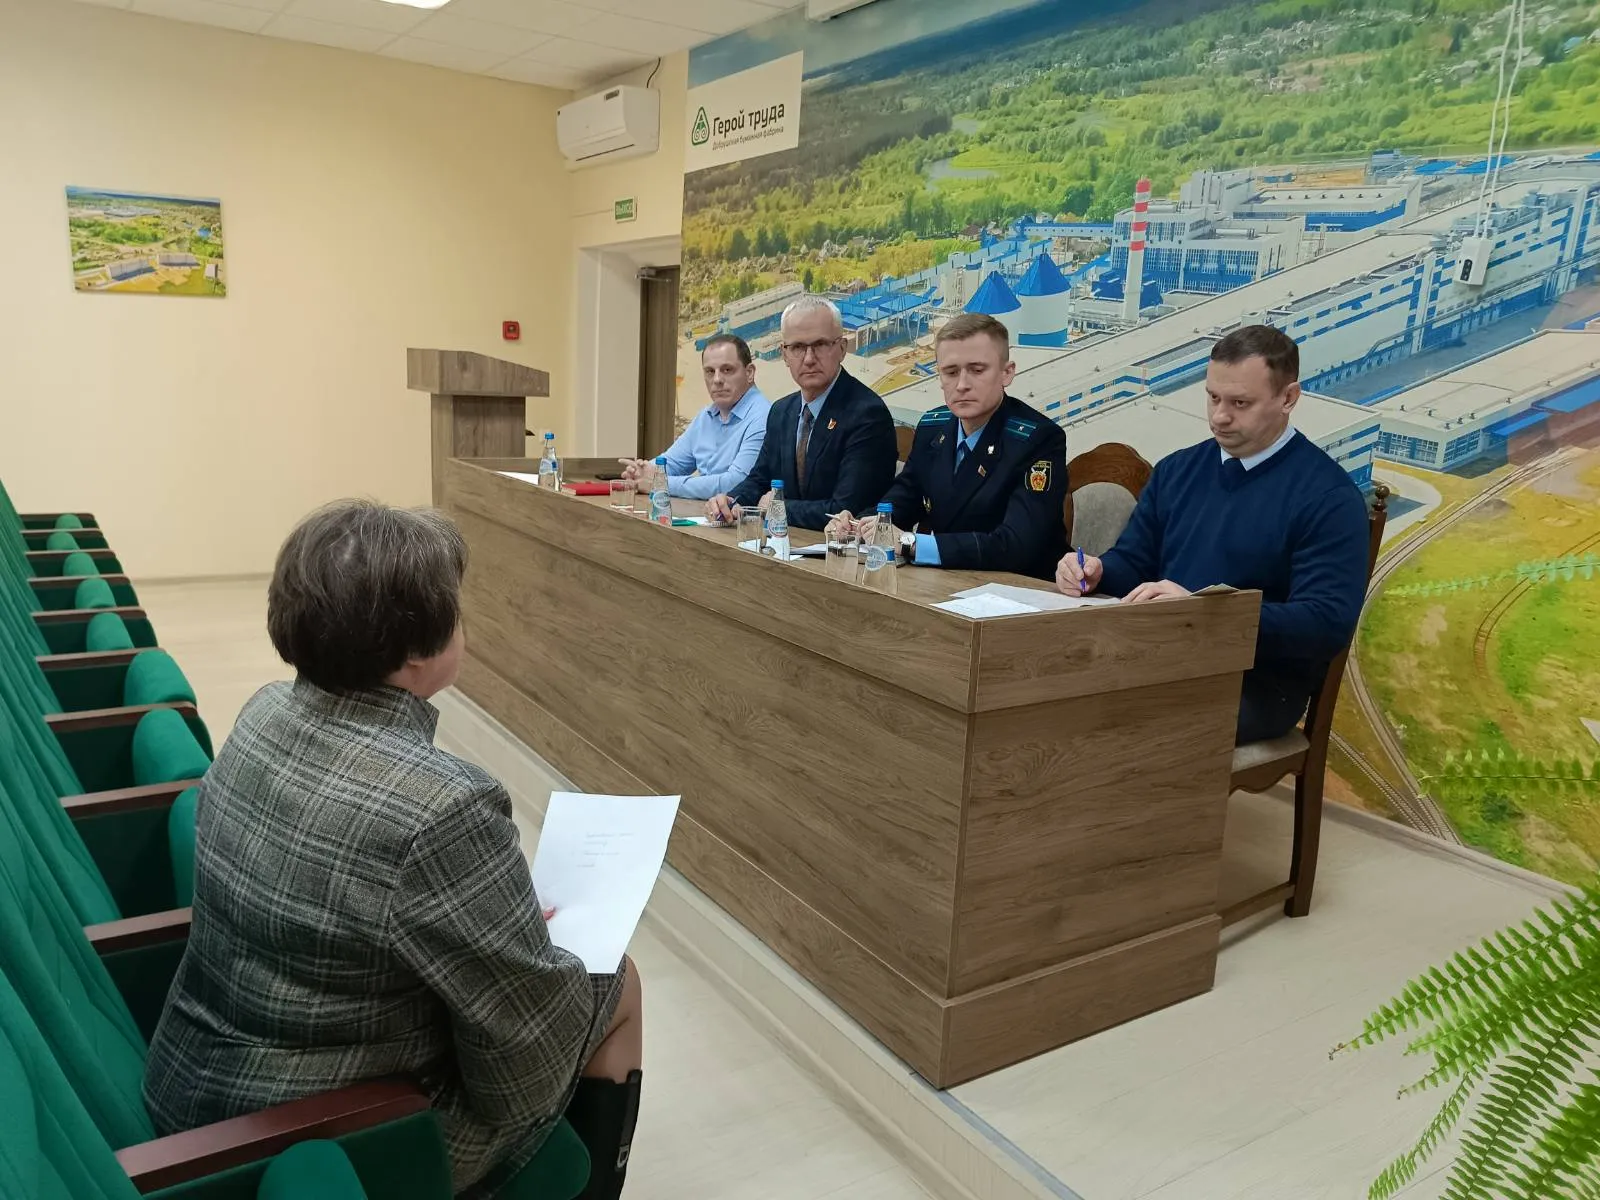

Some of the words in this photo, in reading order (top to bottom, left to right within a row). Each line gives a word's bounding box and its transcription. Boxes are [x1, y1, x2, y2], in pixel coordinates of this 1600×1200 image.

[713, 109, 745, 139] Герой
[748, 103, 785, 131] труда
[763, 126, 784, 138] фабрика
